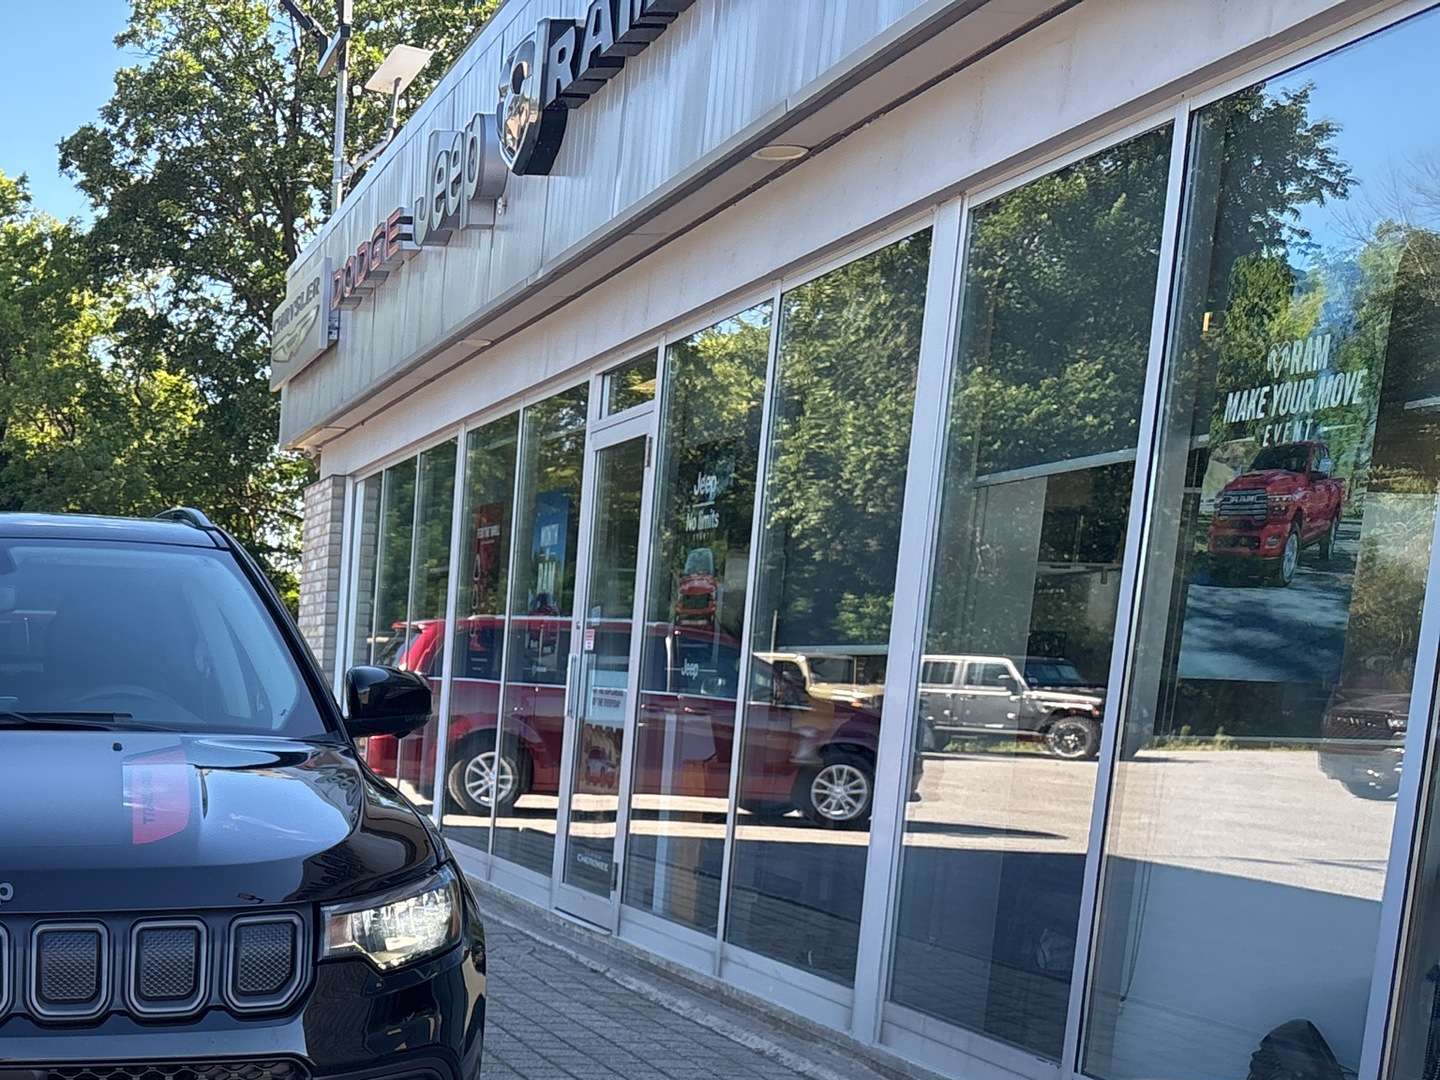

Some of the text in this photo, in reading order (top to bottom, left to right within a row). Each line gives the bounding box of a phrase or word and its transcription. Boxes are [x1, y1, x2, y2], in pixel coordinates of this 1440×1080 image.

[414, 112, 485, 246] Jeep
[330, 207, 402, 311] DODGE
[272, 276, 321, 338] CHRYSLER
[1290, 334, 1331, 375] RAM
[1223, 369, 1368, 424] MAKE YOUR MOVE
[1262, 418, 1314, 447] EVENT
[693, 471, 718, 501] Jeep
[685, 512, 697, 532] No
[681, 659, 699, 679] Jeep
